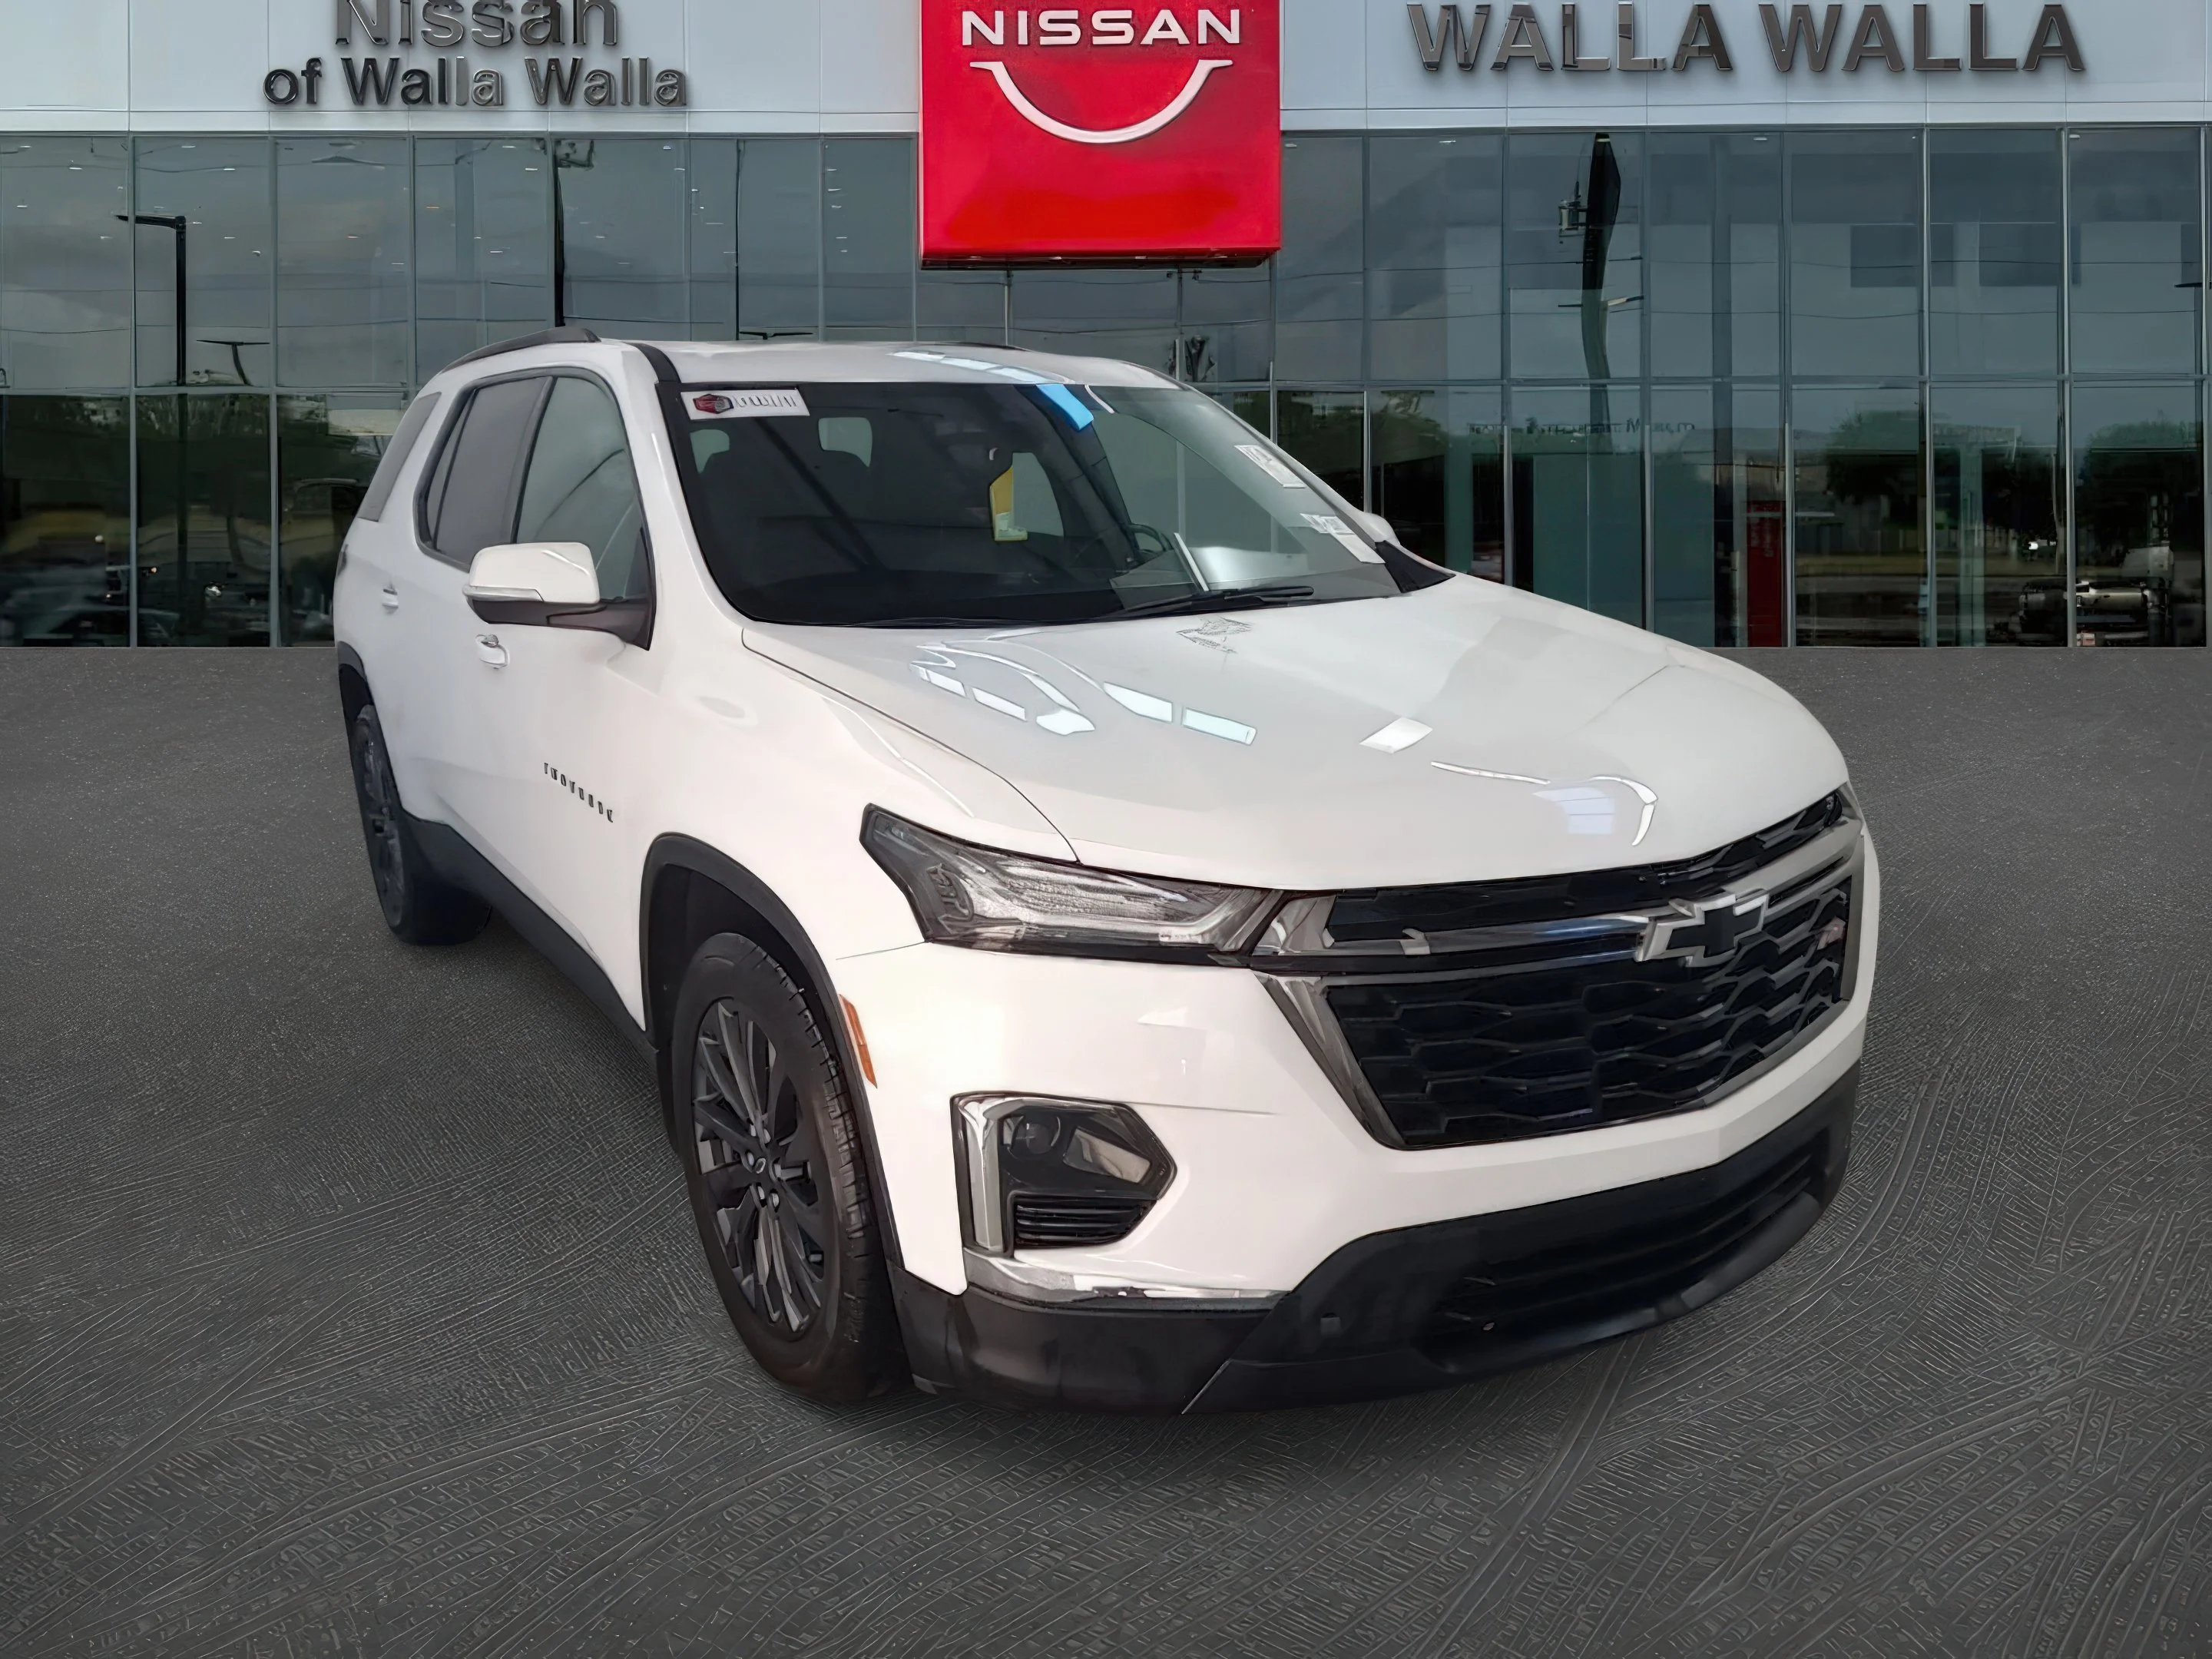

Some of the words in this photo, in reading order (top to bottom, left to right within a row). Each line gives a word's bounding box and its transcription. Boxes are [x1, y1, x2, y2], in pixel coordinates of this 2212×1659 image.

[336, 0, 618, 47] Nissan
[962, 8, 1240, 46] NISSAN
[1406, 3, 1734, 72] WALLA
[1758, 3, 2086, 72] WALLA
[263, 57, 323, 105] of
[340, 56, 504, 105] Walla
[524, 56, 687, 106] Walla
